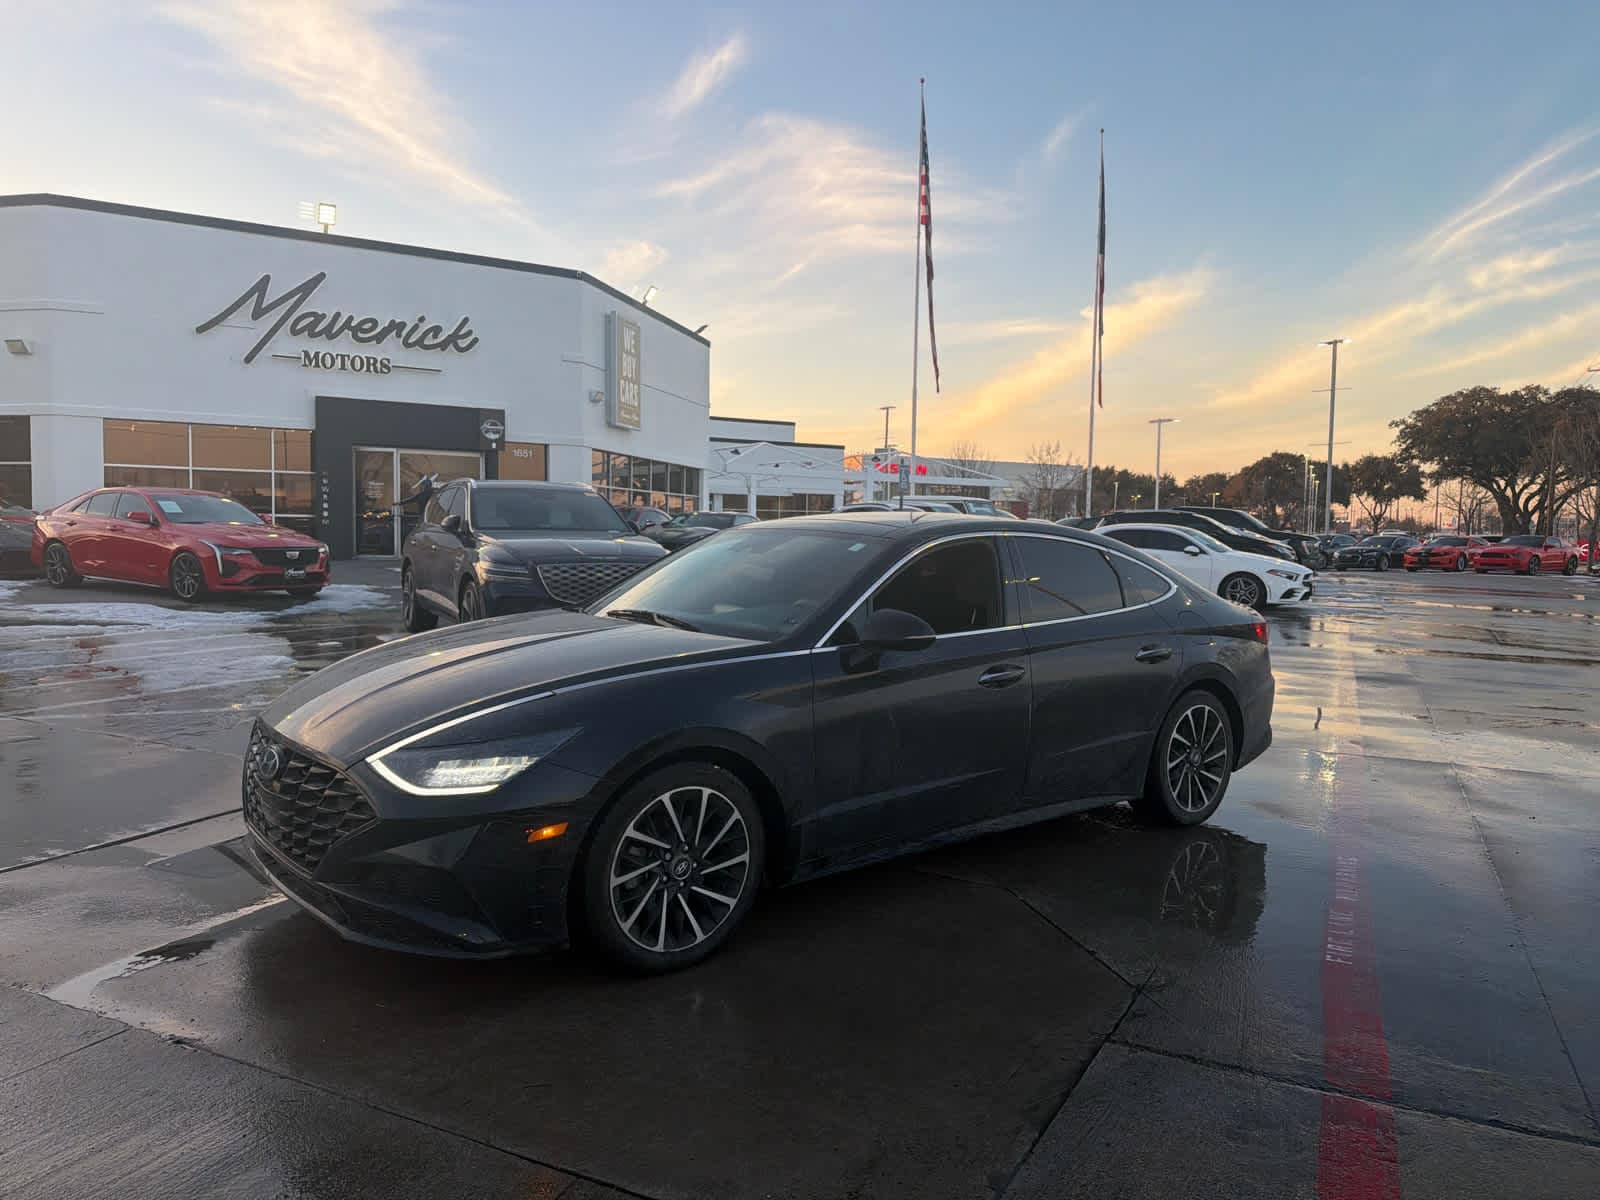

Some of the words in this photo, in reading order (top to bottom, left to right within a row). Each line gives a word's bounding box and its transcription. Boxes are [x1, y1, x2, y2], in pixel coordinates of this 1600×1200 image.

[195, 271, 480, 365] Maverick
[623, 326, 636, 353] WE
[300, 350, 393, 375] MOTORS
[619, 380, 639, 408] CARS
